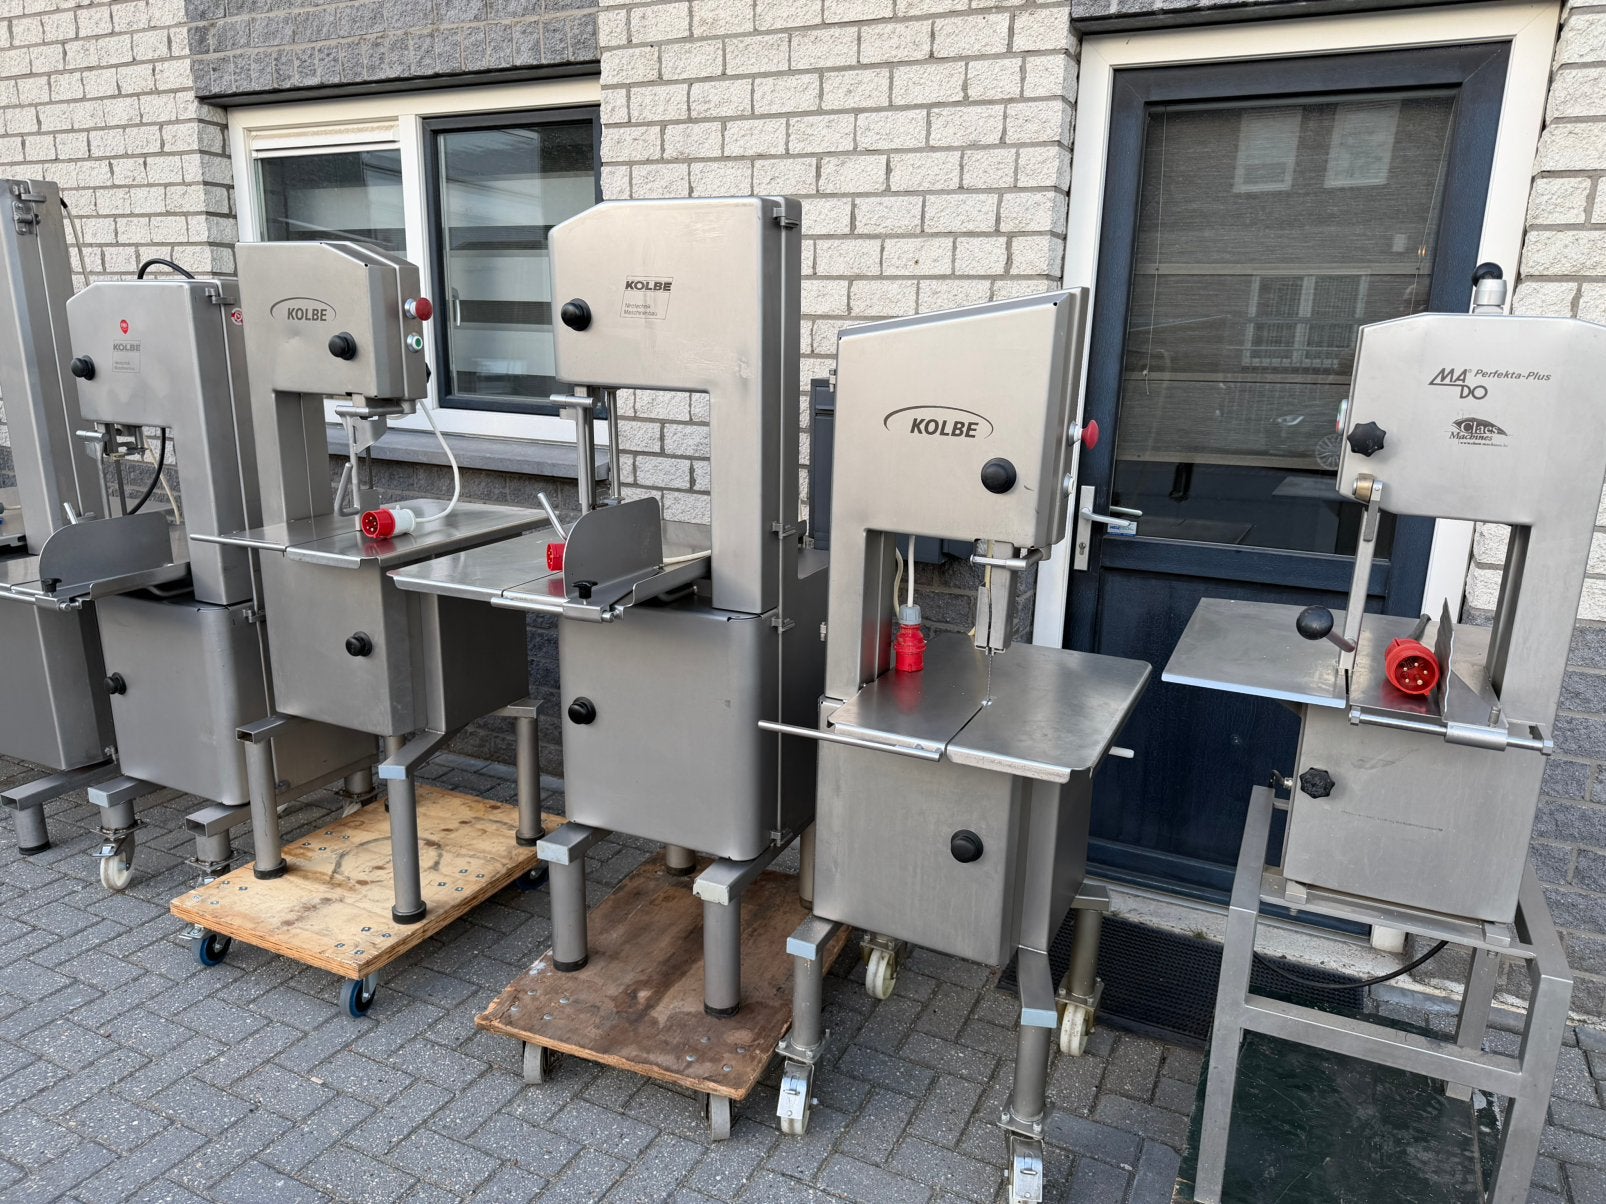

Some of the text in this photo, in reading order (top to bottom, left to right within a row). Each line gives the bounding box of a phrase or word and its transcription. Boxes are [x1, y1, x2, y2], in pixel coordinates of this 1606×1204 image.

[625, 281, 672, 291] KOLBE
[287, 307, 327, 322] KOLBE
[113, 343, 141, 352] KOLBE
[1474, 369, 1551, 381] Perfekta-Plus
[910, 418, 979, 438] KOLBE
[1460, 421, 1498, 434] Claes
[1449, 431, 1493, 441] Machines
